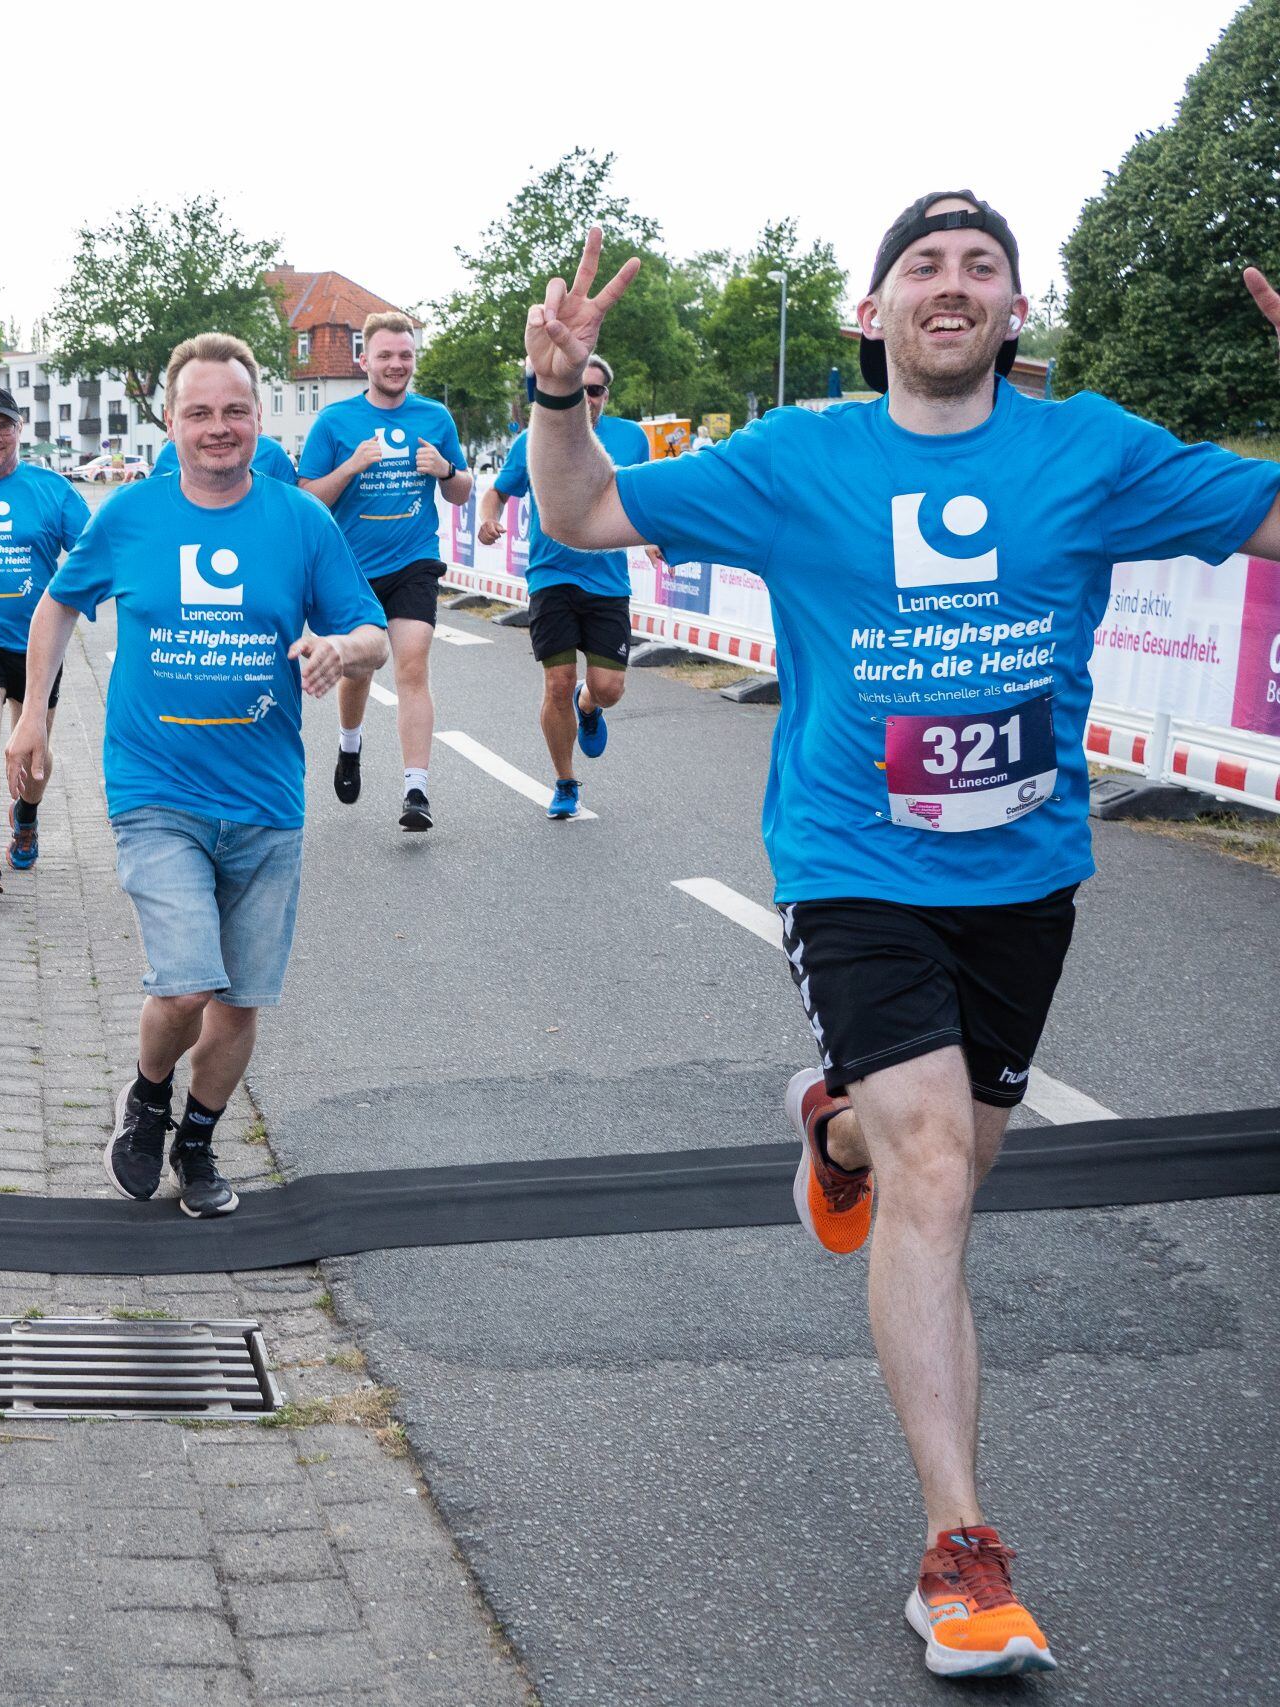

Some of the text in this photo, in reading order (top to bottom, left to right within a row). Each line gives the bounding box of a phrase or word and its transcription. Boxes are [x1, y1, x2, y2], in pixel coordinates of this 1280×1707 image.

[386, 482, 400, 490] die
[1114, 588, 1138, 613] sind
[1140, 590, 1172, 618] aktiv.
[150, 628, 278, 648] Mit Highspeed
[851, 610, 1056, 650] Mit Highspeed
[1110, 624, 1140, 652] deine
[1142, 630, 1220, 664] Gesundheit.
[150, 648, 276, 666] durch die Heide!
[854, 642, 1056, 681] durch die Heide!
[154, 669, 174, 678] Nichts
[176, 671, 192, 680] läuft
[194, 672, 230, 682] schneller
[858, 674, 1055, 704] Nichts läuft schneller als Glasfaser.
[922, 714, 1021, 775] 321
[949, 772, 1008, 789] Lünecom
